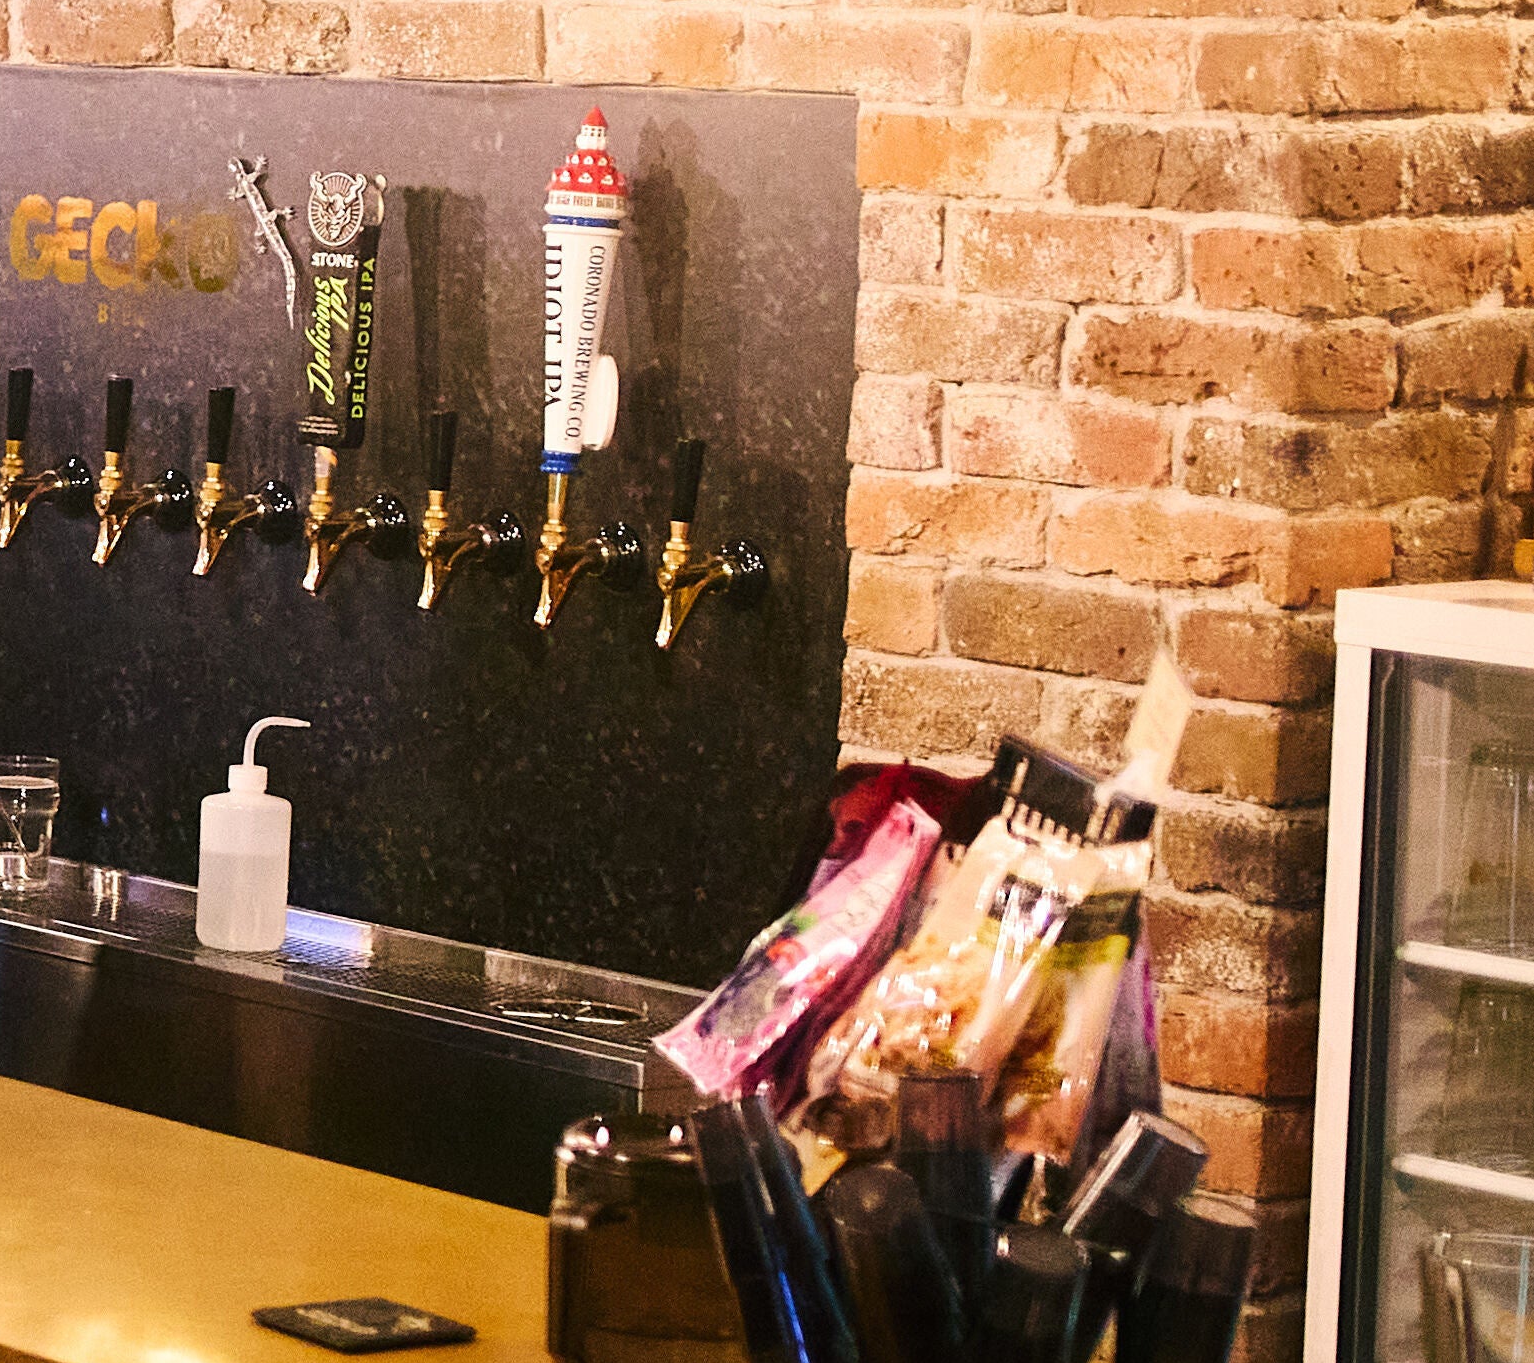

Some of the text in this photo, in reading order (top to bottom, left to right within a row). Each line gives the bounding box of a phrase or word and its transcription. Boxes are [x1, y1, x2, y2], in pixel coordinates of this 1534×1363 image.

[8, 193, 241, 294] GECKO
[311, 252, 355, 268] STONE
[545, 245, 563, 345] IDIOT
[305, 276, 349, 405] Delicious IPA
[351, 258, 376, 419] DELICIOUS IPA
[564, 246, 606, 442] CORONADO BREWING CO.
